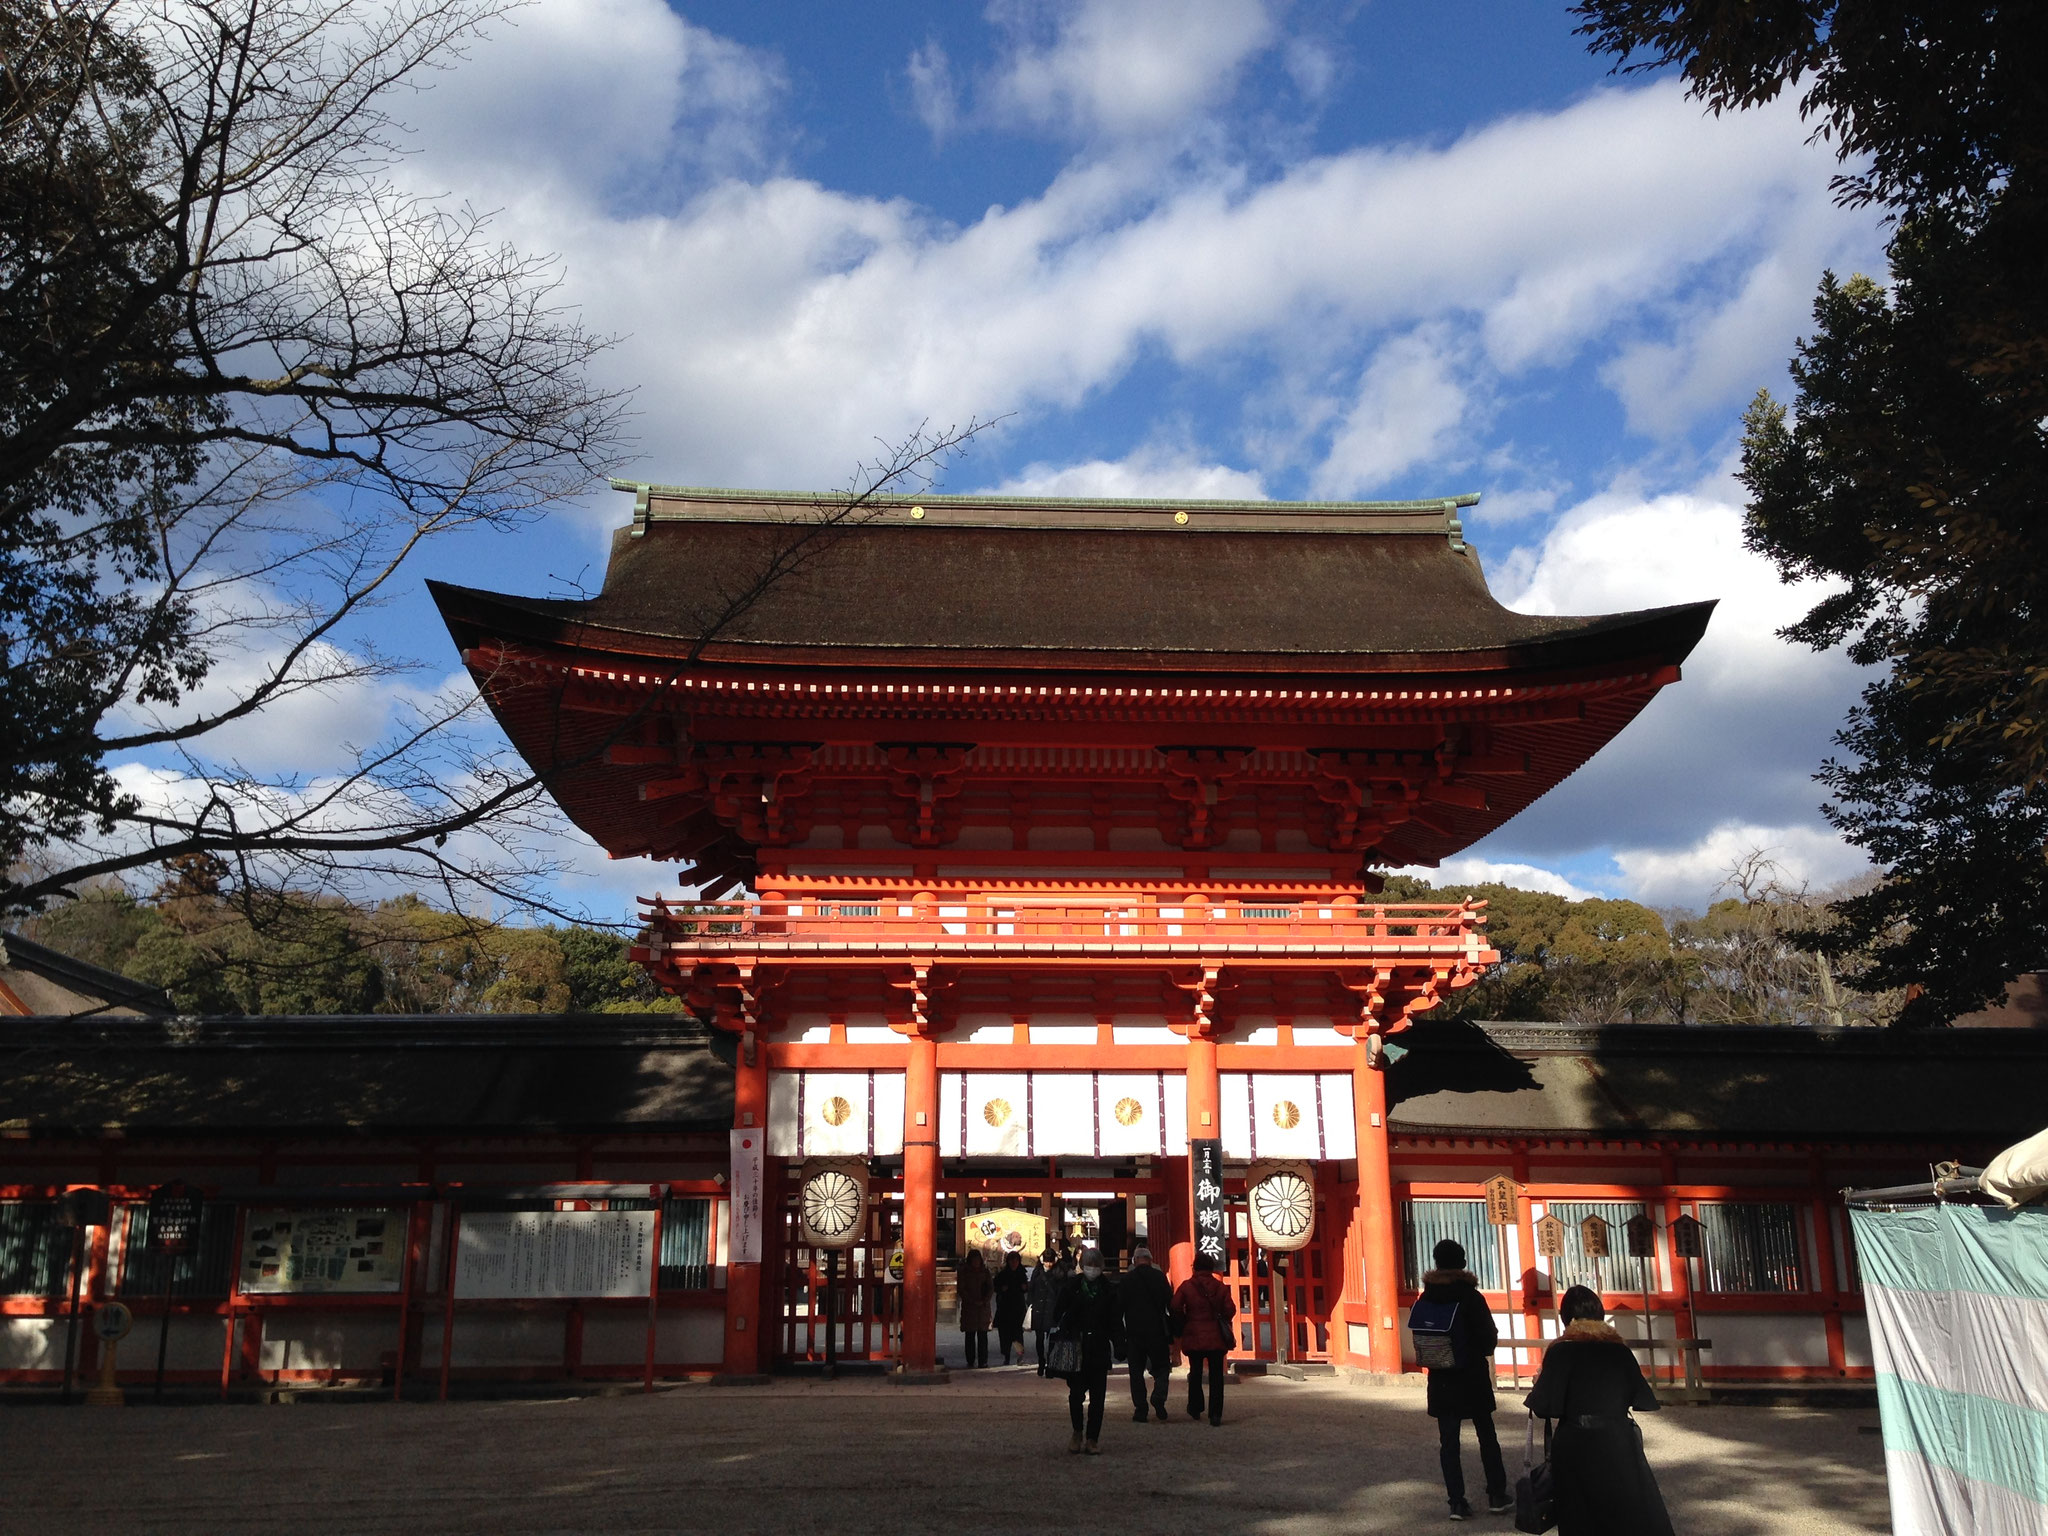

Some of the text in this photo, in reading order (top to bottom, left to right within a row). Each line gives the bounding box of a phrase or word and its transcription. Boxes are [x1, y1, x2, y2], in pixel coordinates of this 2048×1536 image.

[1197, 1179, 1223, 1260] 御粥祭
[1497, 1181, 1509, 1222] 天皇陛下
